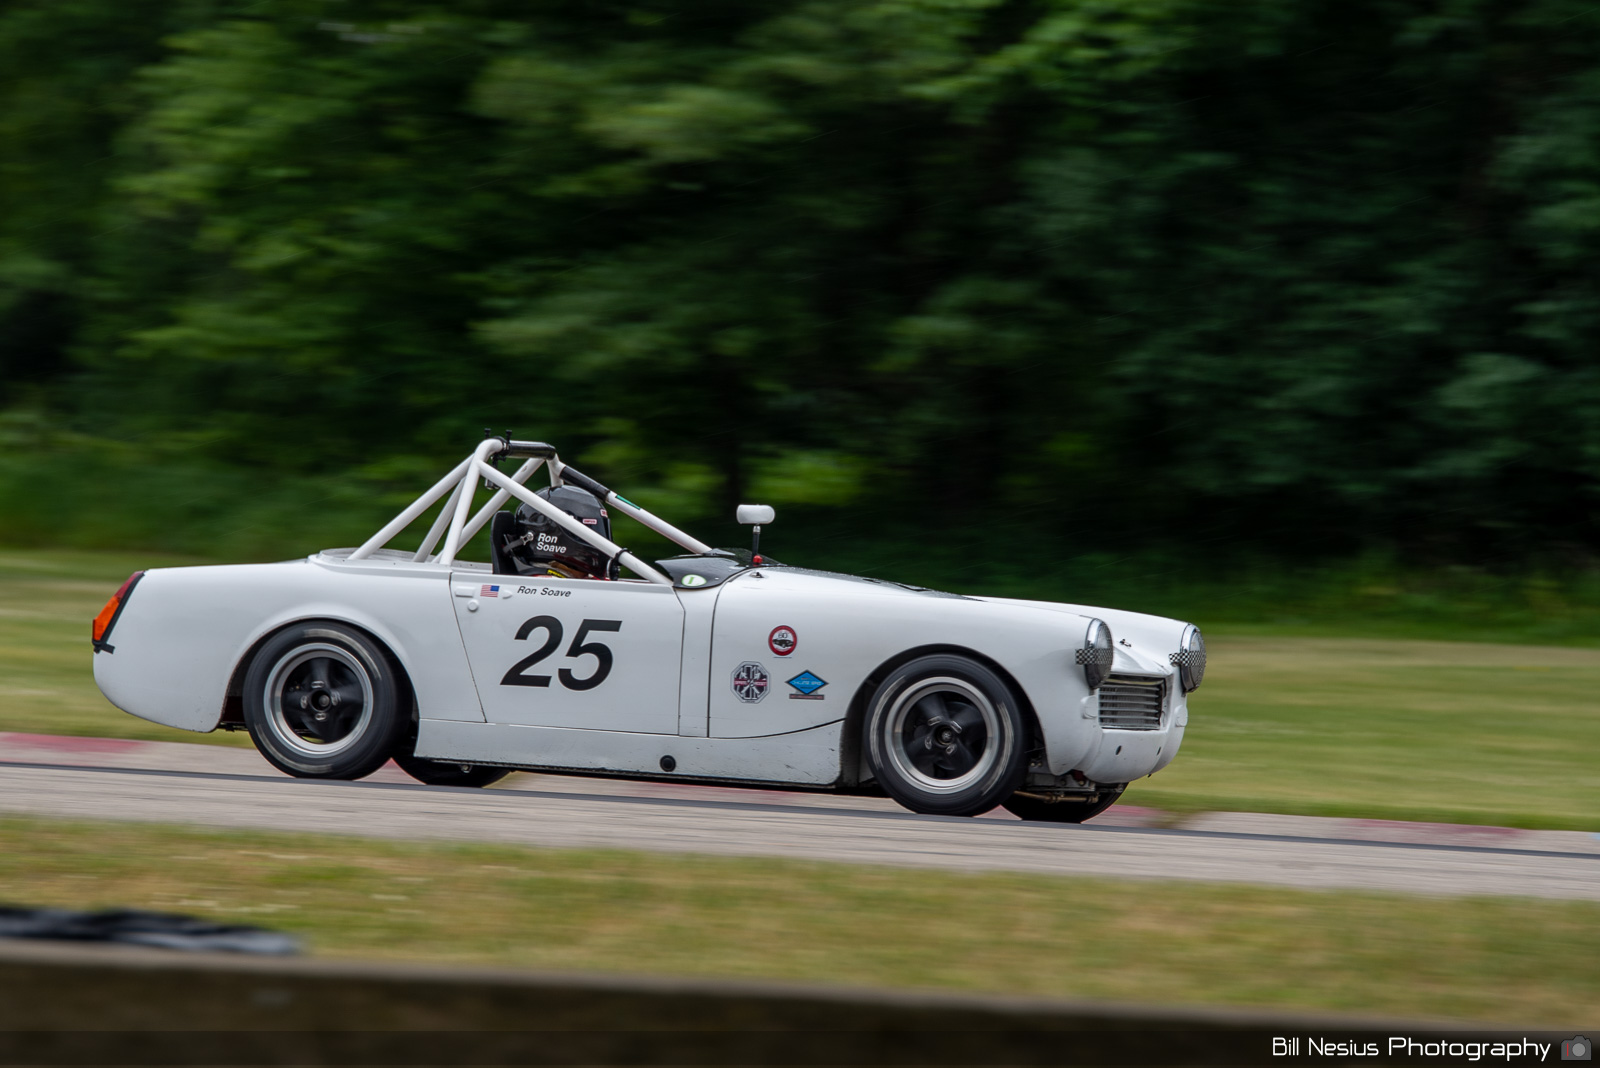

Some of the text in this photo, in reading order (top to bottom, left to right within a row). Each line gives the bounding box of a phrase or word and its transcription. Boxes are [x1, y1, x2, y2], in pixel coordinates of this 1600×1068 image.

[537, 532, 558, 543] Ron
[536, 542, 567, 554] Soave
[517, 584, 571, 597] Ron Soave
[500, 615, 622, 691] 25
